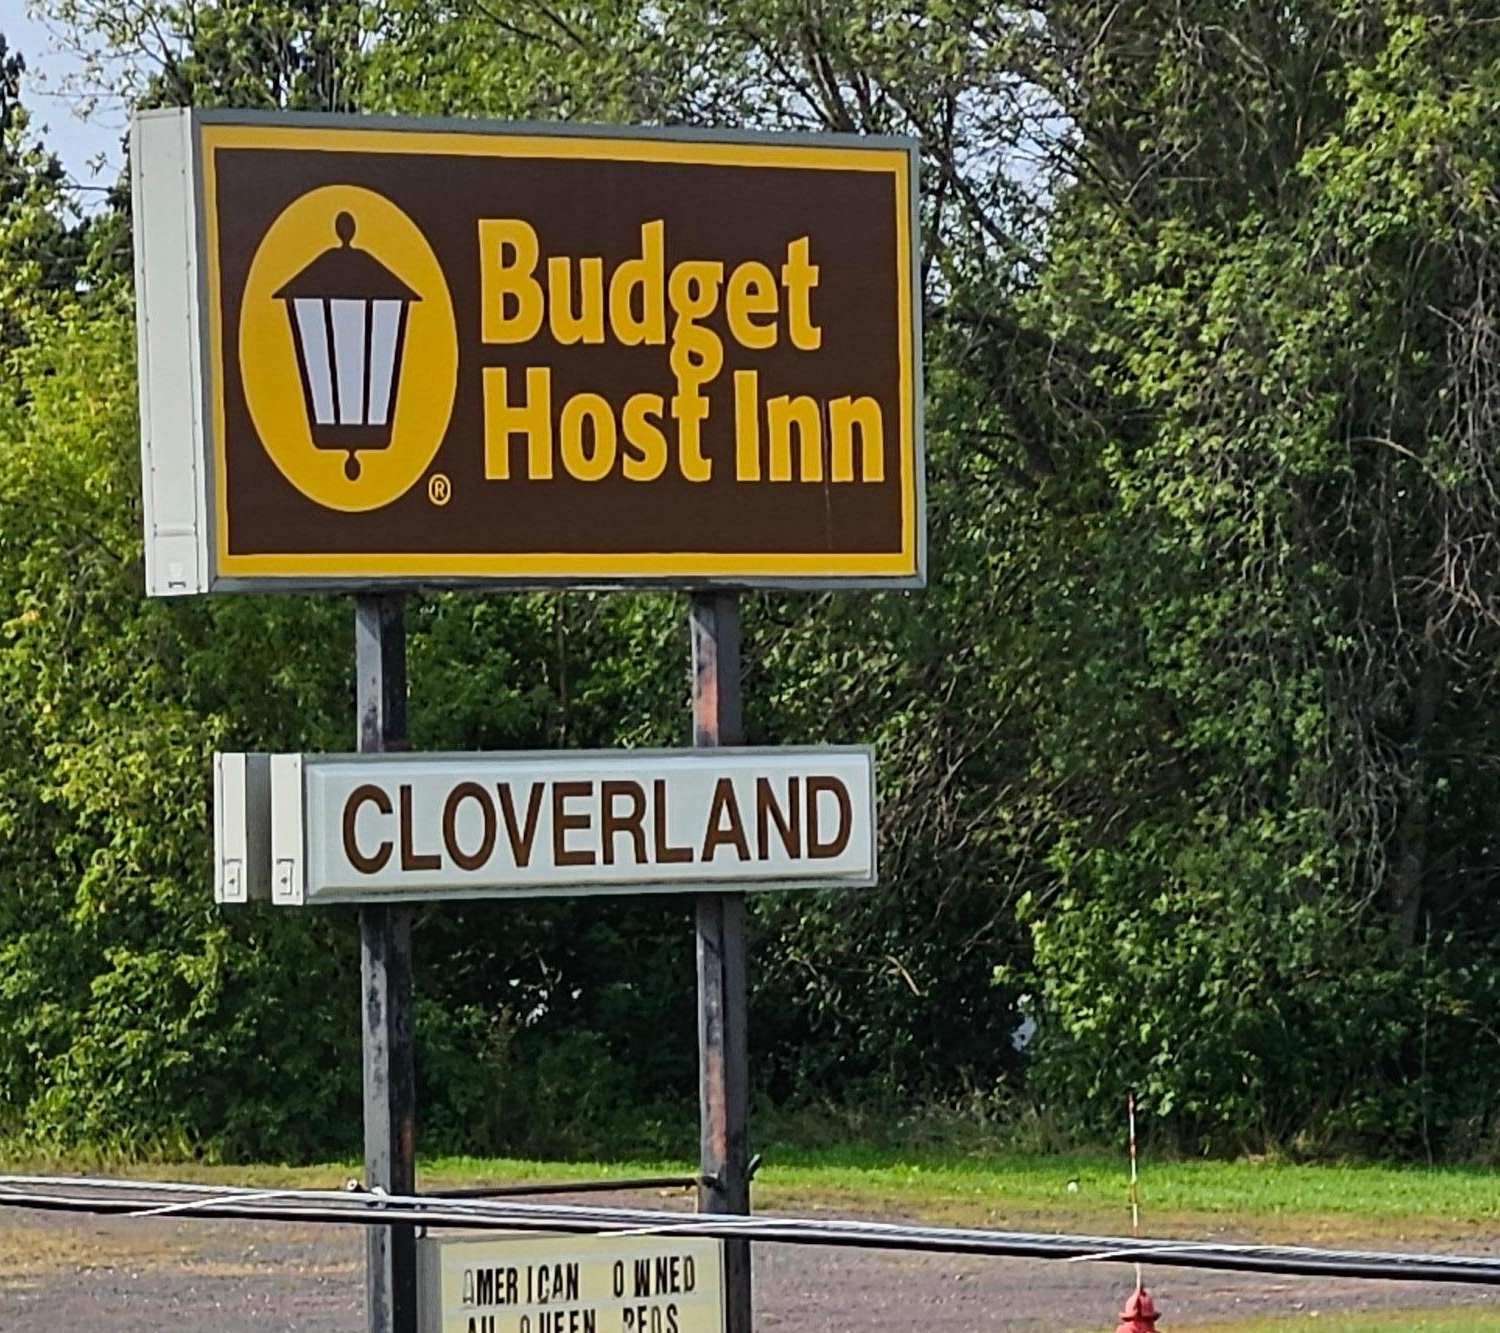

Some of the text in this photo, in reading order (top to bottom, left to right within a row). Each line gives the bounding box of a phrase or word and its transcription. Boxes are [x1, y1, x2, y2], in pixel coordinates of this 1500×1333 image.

[478, 219, 822, 385] Budget
[481, 366, 885, 484] Host Inn
[342, 775, 853, 874] CLOVERLAND
[462, 1255, 695, 1307] AMERICAN OWNED
